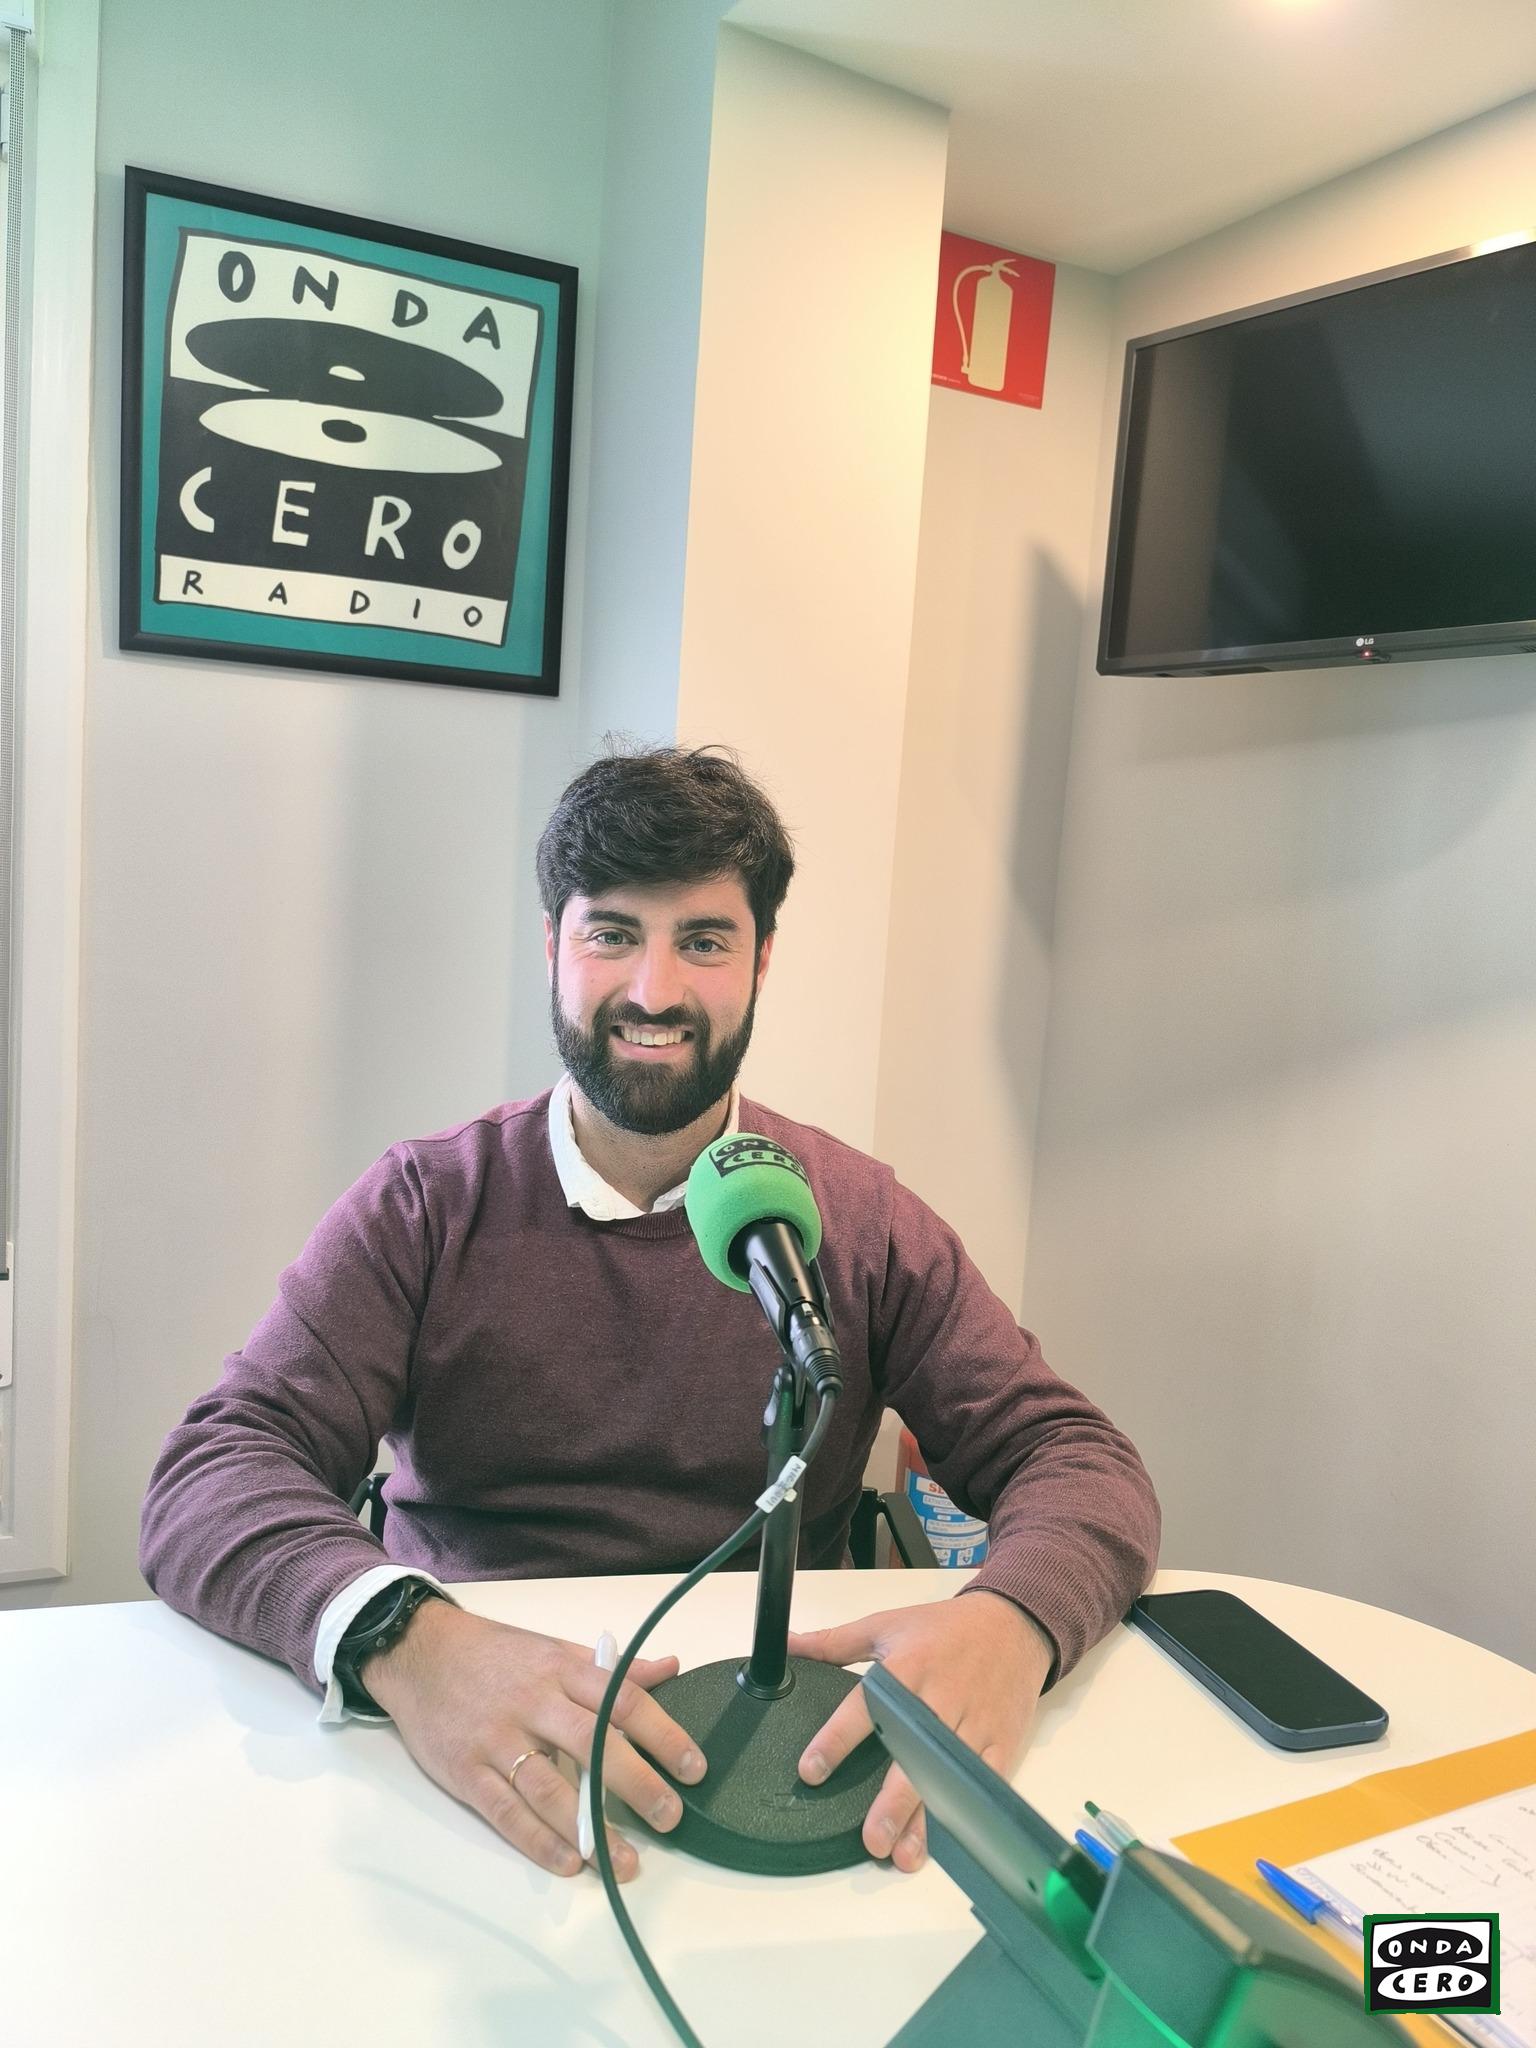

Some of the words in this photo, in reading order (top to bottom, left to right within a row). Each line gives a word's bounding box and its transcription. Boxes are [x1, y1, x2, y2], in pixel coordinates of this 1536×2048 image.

[218, 251, 500, 350] ONDA
[179, 466, 482, 570] CERO
[183, 570, 482, 627] RADIO
